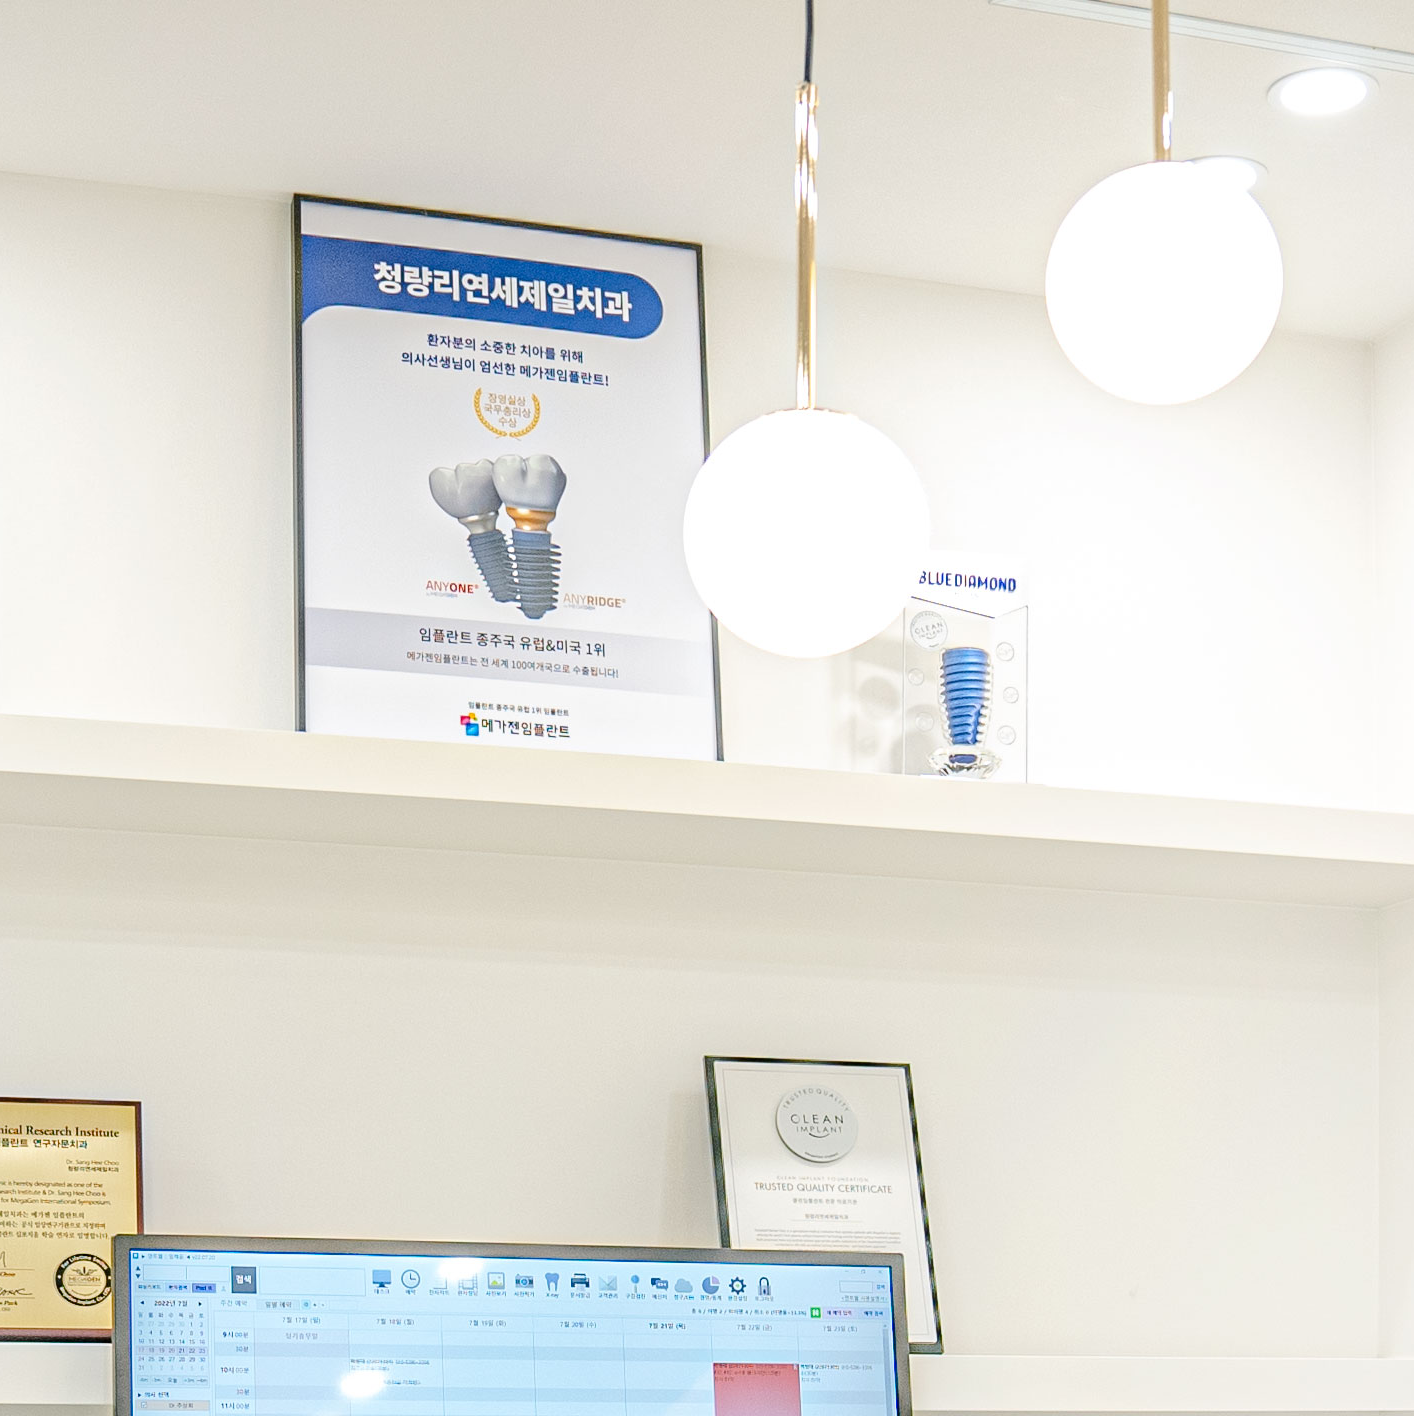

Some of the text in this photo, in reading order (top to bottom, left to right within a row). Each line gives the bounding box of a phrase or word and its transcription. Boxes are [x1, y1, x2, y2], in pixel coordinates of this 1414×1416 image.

[373, 261, 632, 322] 청량리연세제일치과
[426, 333, 583, 363] 환자분의 소중한 치아를 위해
[402, 352, 609, 386] 의사선생님이 엄선한 메가젠임플란트!
[499, 416, 517, 427] 수상
[419, 628, 606, 657] 임플란트 종주국 유럽&미국 1위
[407, 652, 478, 666] 메가젠임플란트는
[480, 657, 489, 667] 전
[491, 658, 509, 669] 세계
[468, 702, 494, 711] 임플란트
[543, 708, 569, 717] 임플란트
[481, 718, 571, 739] 메가젠임플란트
[790, 1114, 844, 1124] CLEAN
[26, 1125, 72, 1136] Research
[75, 1126, 119, 1138] Institute
[796, 1126, 843, 1134] IMPLANT
[754, 1182, 892, 1194] TRUSTED QUALITY CERTIFICATE
[236, 1274, 252, 1284] 검색
